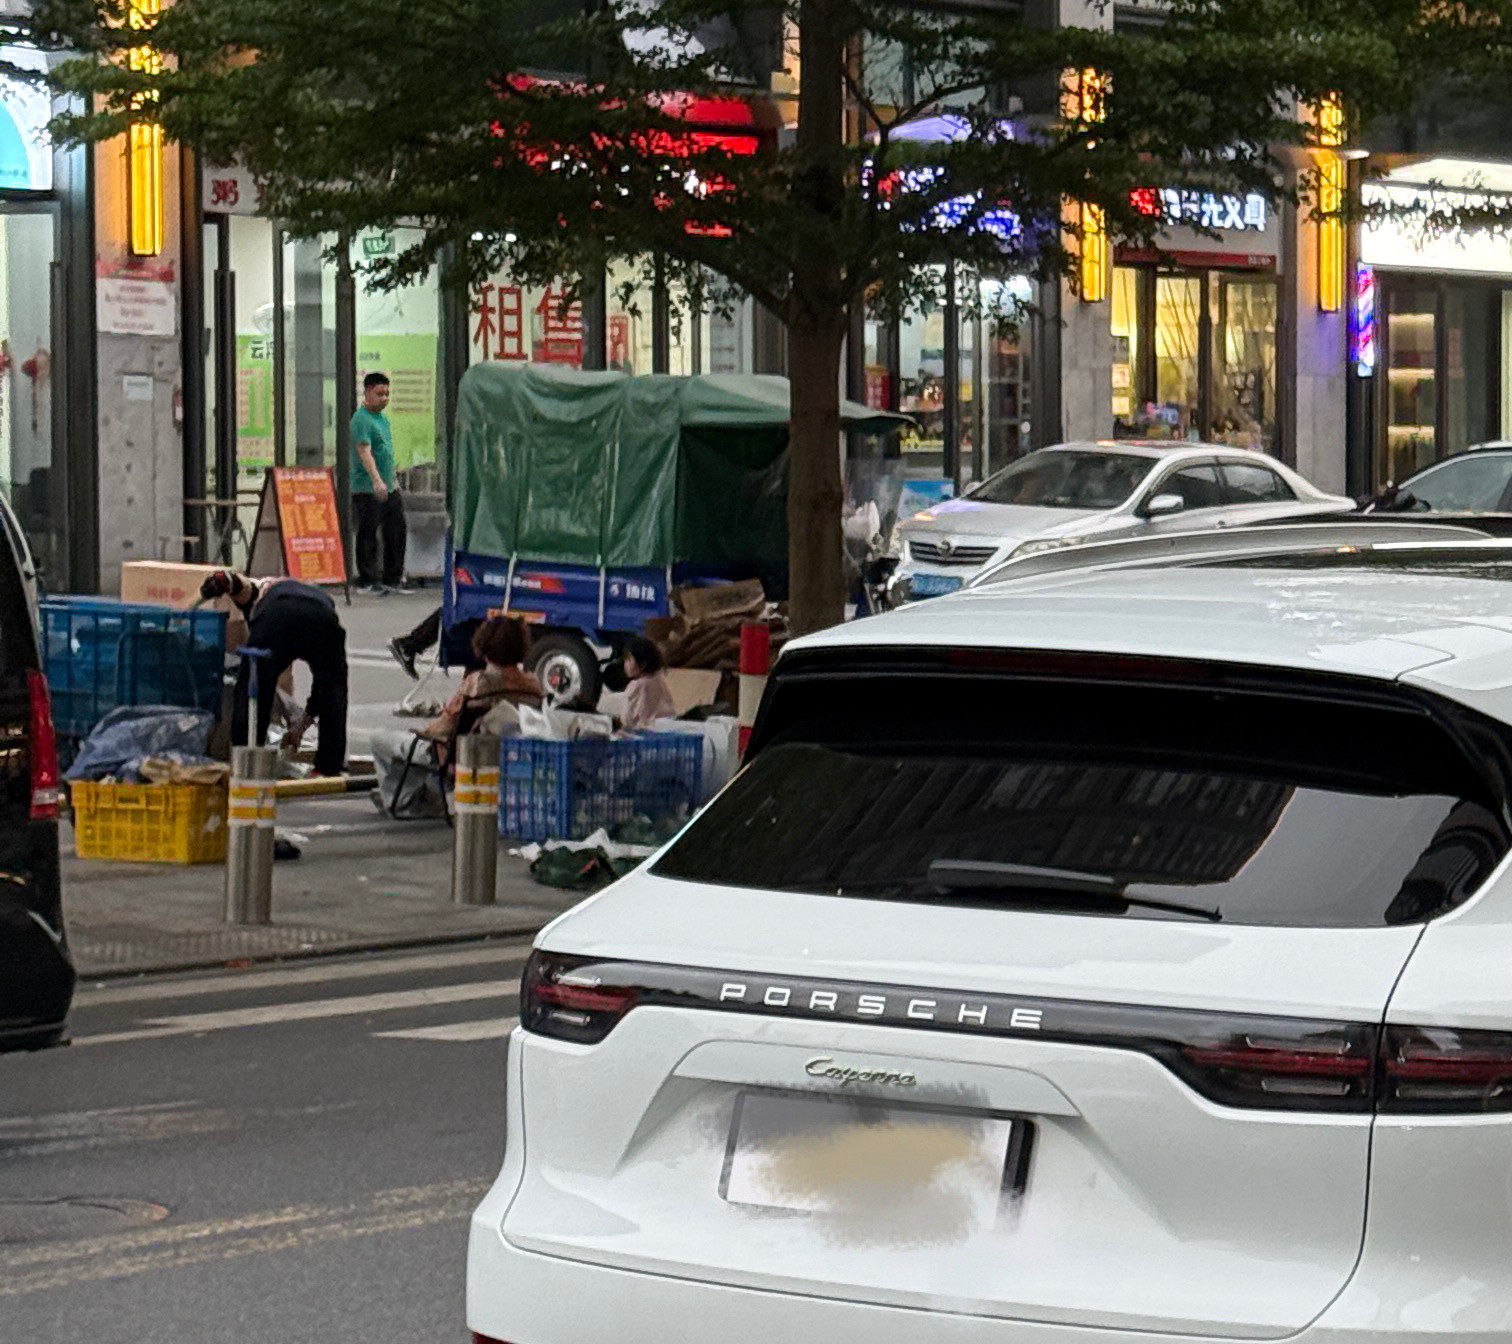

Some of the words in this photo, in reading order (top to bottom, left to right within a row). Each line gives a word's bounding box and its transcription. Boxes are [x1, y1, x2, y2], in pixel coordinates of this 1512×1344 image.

[472, 284, 584, 368] 租售
[720, 982, 1043, 1030] PORSCHE
[805, 1055, 917, 1089] Cayenne
